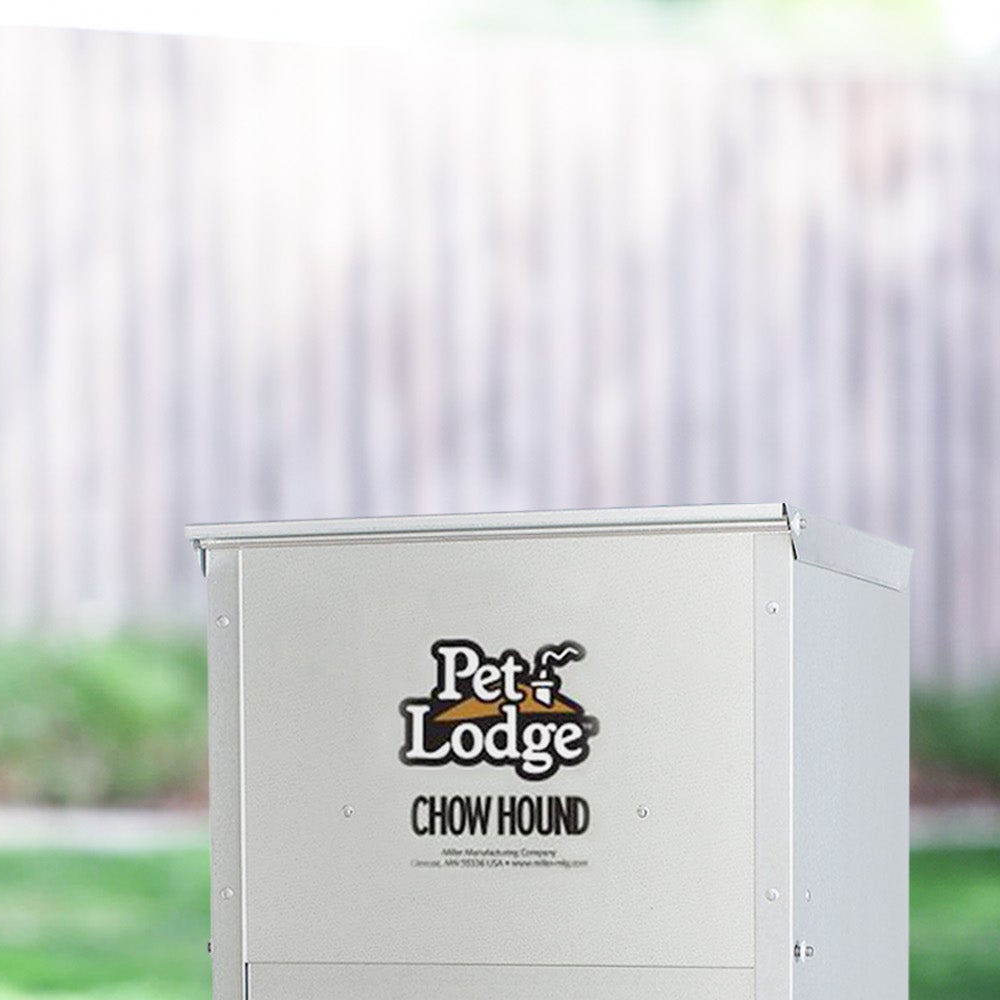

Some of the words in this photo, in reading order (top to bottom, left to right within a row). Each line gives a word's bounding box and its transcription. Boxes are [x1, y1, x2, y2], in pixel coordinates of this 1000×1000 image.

[437, 646, 525, 701] Pet
[405, 704, 583, 774] Lodge
[411, 795, 493, 836] CHOW
[498, 795, 590, 836] HOUND
[486, 859, 503, 868] USA
[520, 848, 557, 859] Company
